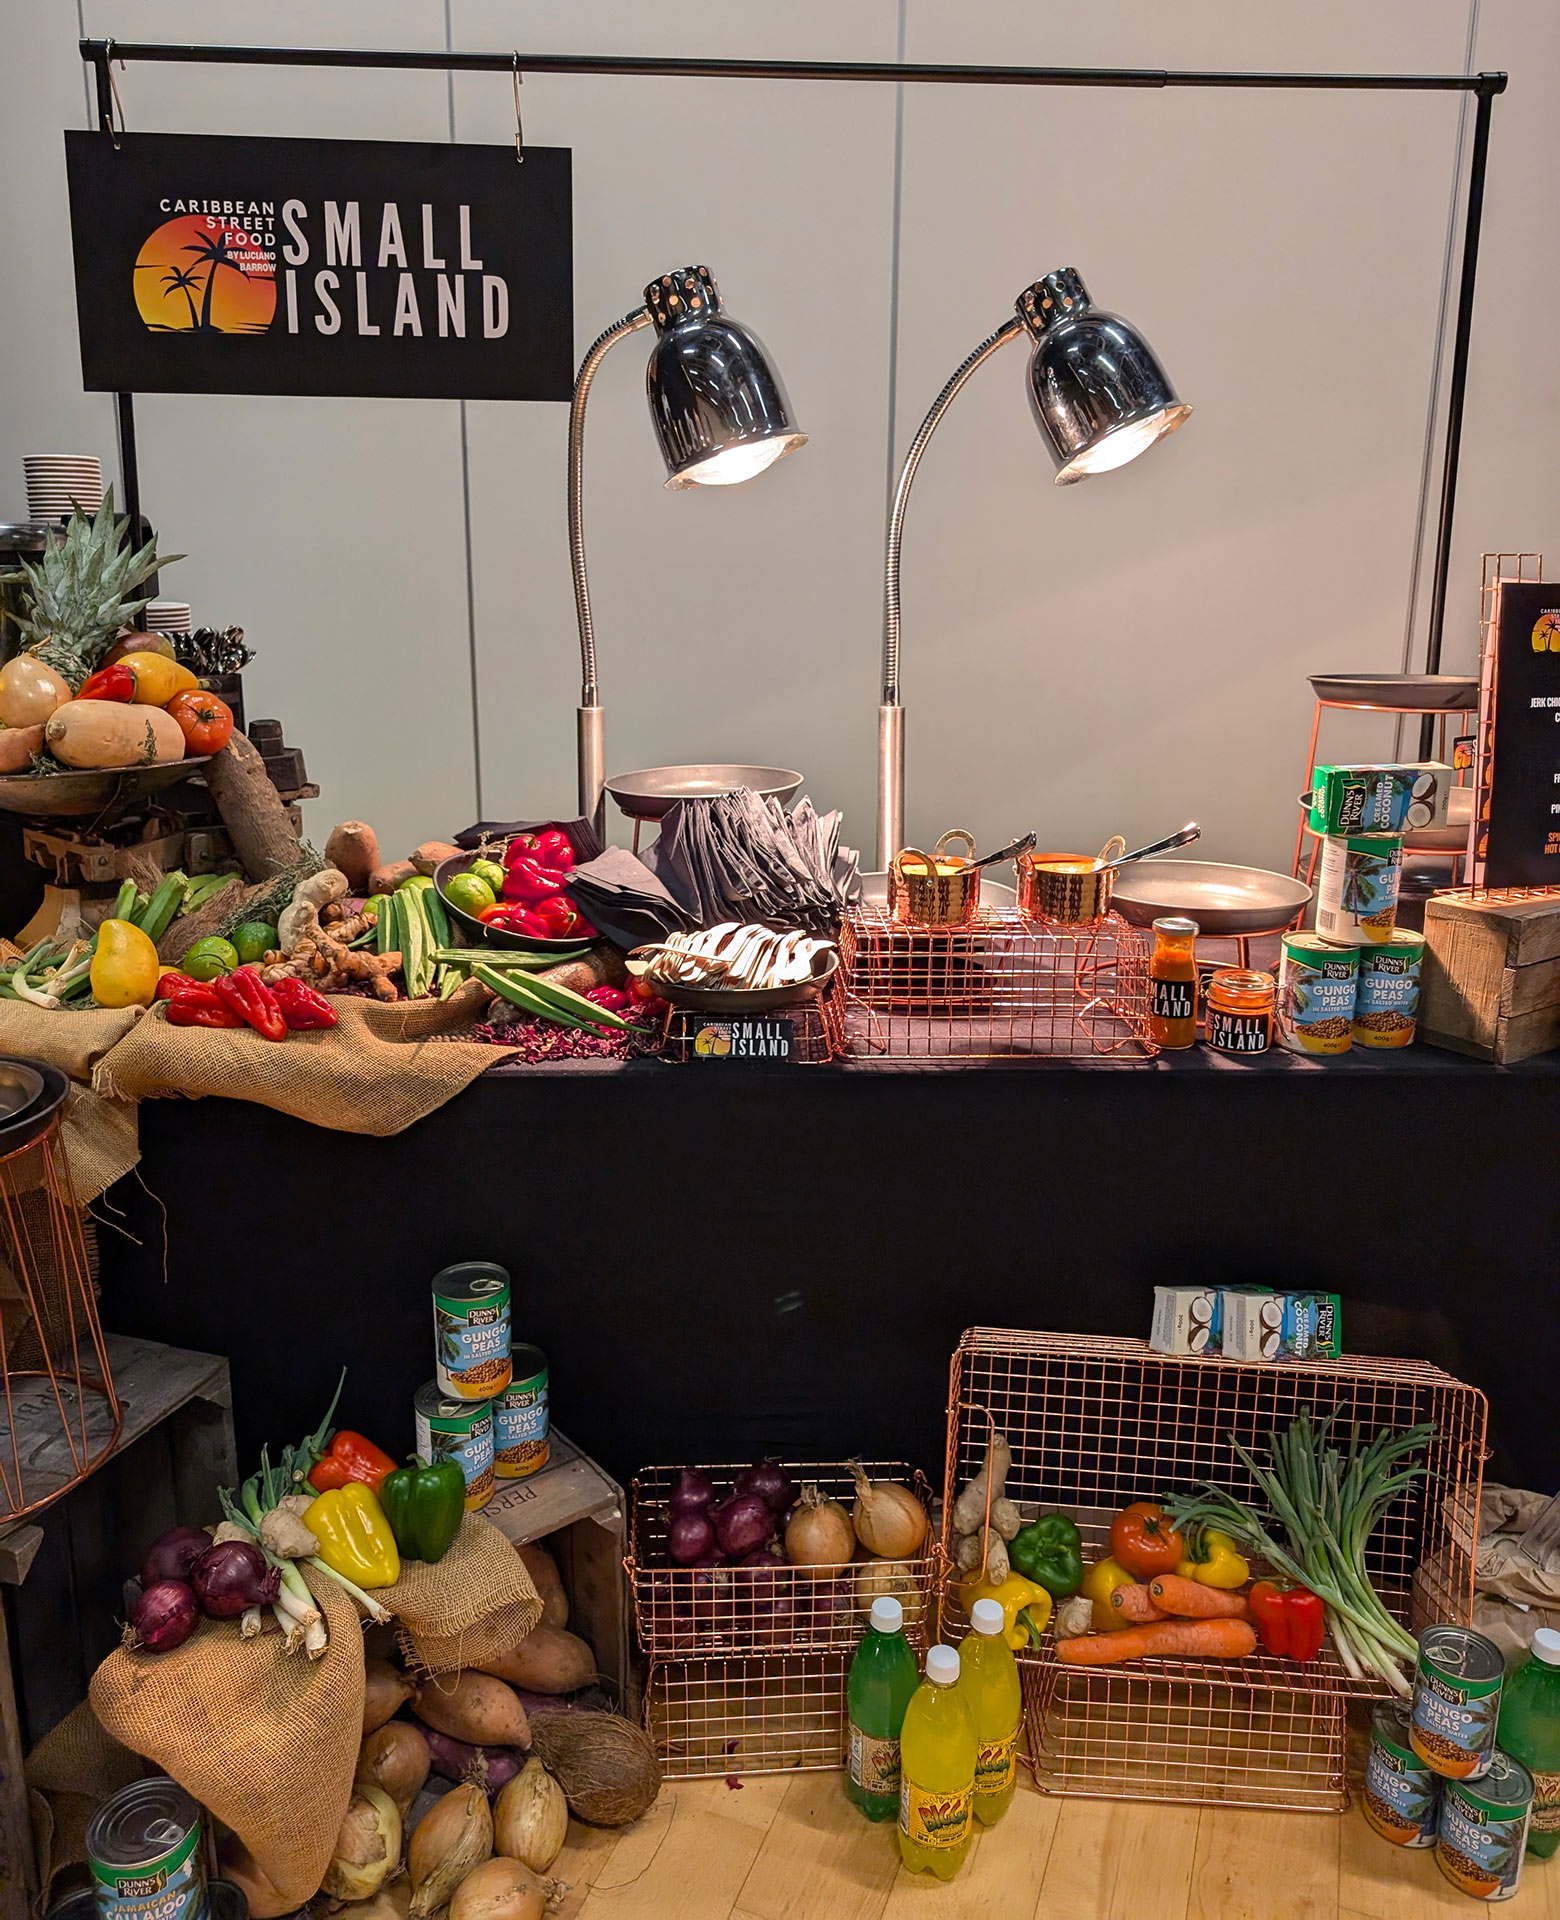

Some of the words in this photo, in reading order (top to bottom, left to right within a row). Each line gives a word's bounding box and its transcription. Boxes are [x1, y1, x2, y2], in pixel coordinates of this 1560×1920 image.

[160, 198, 275, 215] CARIBBEAN
[205, 216, 275, 231] STREET
[224, 233, 276, 246] FOOD
[281, 198, 484, 270] SMALL
[239, 252, 277, 261] LUCIANO
[239, 263, 277, 273] BARROW
[285, 269, 509, 339] ISLAND
[1530, 697, 1546, 708] JERK
[1350, 794, 1363, 821] RIVER
[1373, 782, 1384, 823] CREAMED
[1380, 774, 1394, 829] COCONUT
[1544, 843, 1557, 855] HOT
[1326, 970, 1347, 980] RIVER
[1378, 964, 1401, 974] RIVER
[1313, 984, 1356, 996] GUNGO
[1365, 979, 1413, 990] GUNGO
[1322, 995, 1350, 1006] PEAS
[1373, 990, 1403, 1000] PEAS
[732, 1022, 782, 1039] SMALL
[1214, 1014, 1260, 1034] SMALL
[732, 1039, 789, 1056] ISLAND
[1213, 1029, 1264, 1050] ISLAND
[473, 1316, 494, 1325] RIVER
[1294, 1301, 1303, 1356] COCONUT
[1318, 1310, 1327, 1337] RIVER
[1325, 1305, 1333, 1341] DUNN'S
[461, 1323, 507, 1344] GUNGO
[471, 1336, 500, 1353] PEAS
[509, 1400, 531, 1409] RIVER
[499, 1406, 543, 1425] GUNGO
[508, 1419, 537, 1434] PEAS
[1432, 1684, 1454, 1703] RIVER
[1421, 1692, 1473, 1724] GUNGO
[1427, 1707, 1461, 1732] PEAS
[1370, 1755, 1411, 1793] GUNGO
[1372, 1770, 1399, 1798] PEAS
[1446, 1806, 1493, 1845] GUNGO
[1449, 1822, 1480, 1851] PEAS
[123, 1886, 152, 1897] RIVER
[114, 1890, 177, 1913] JAMAICAN
